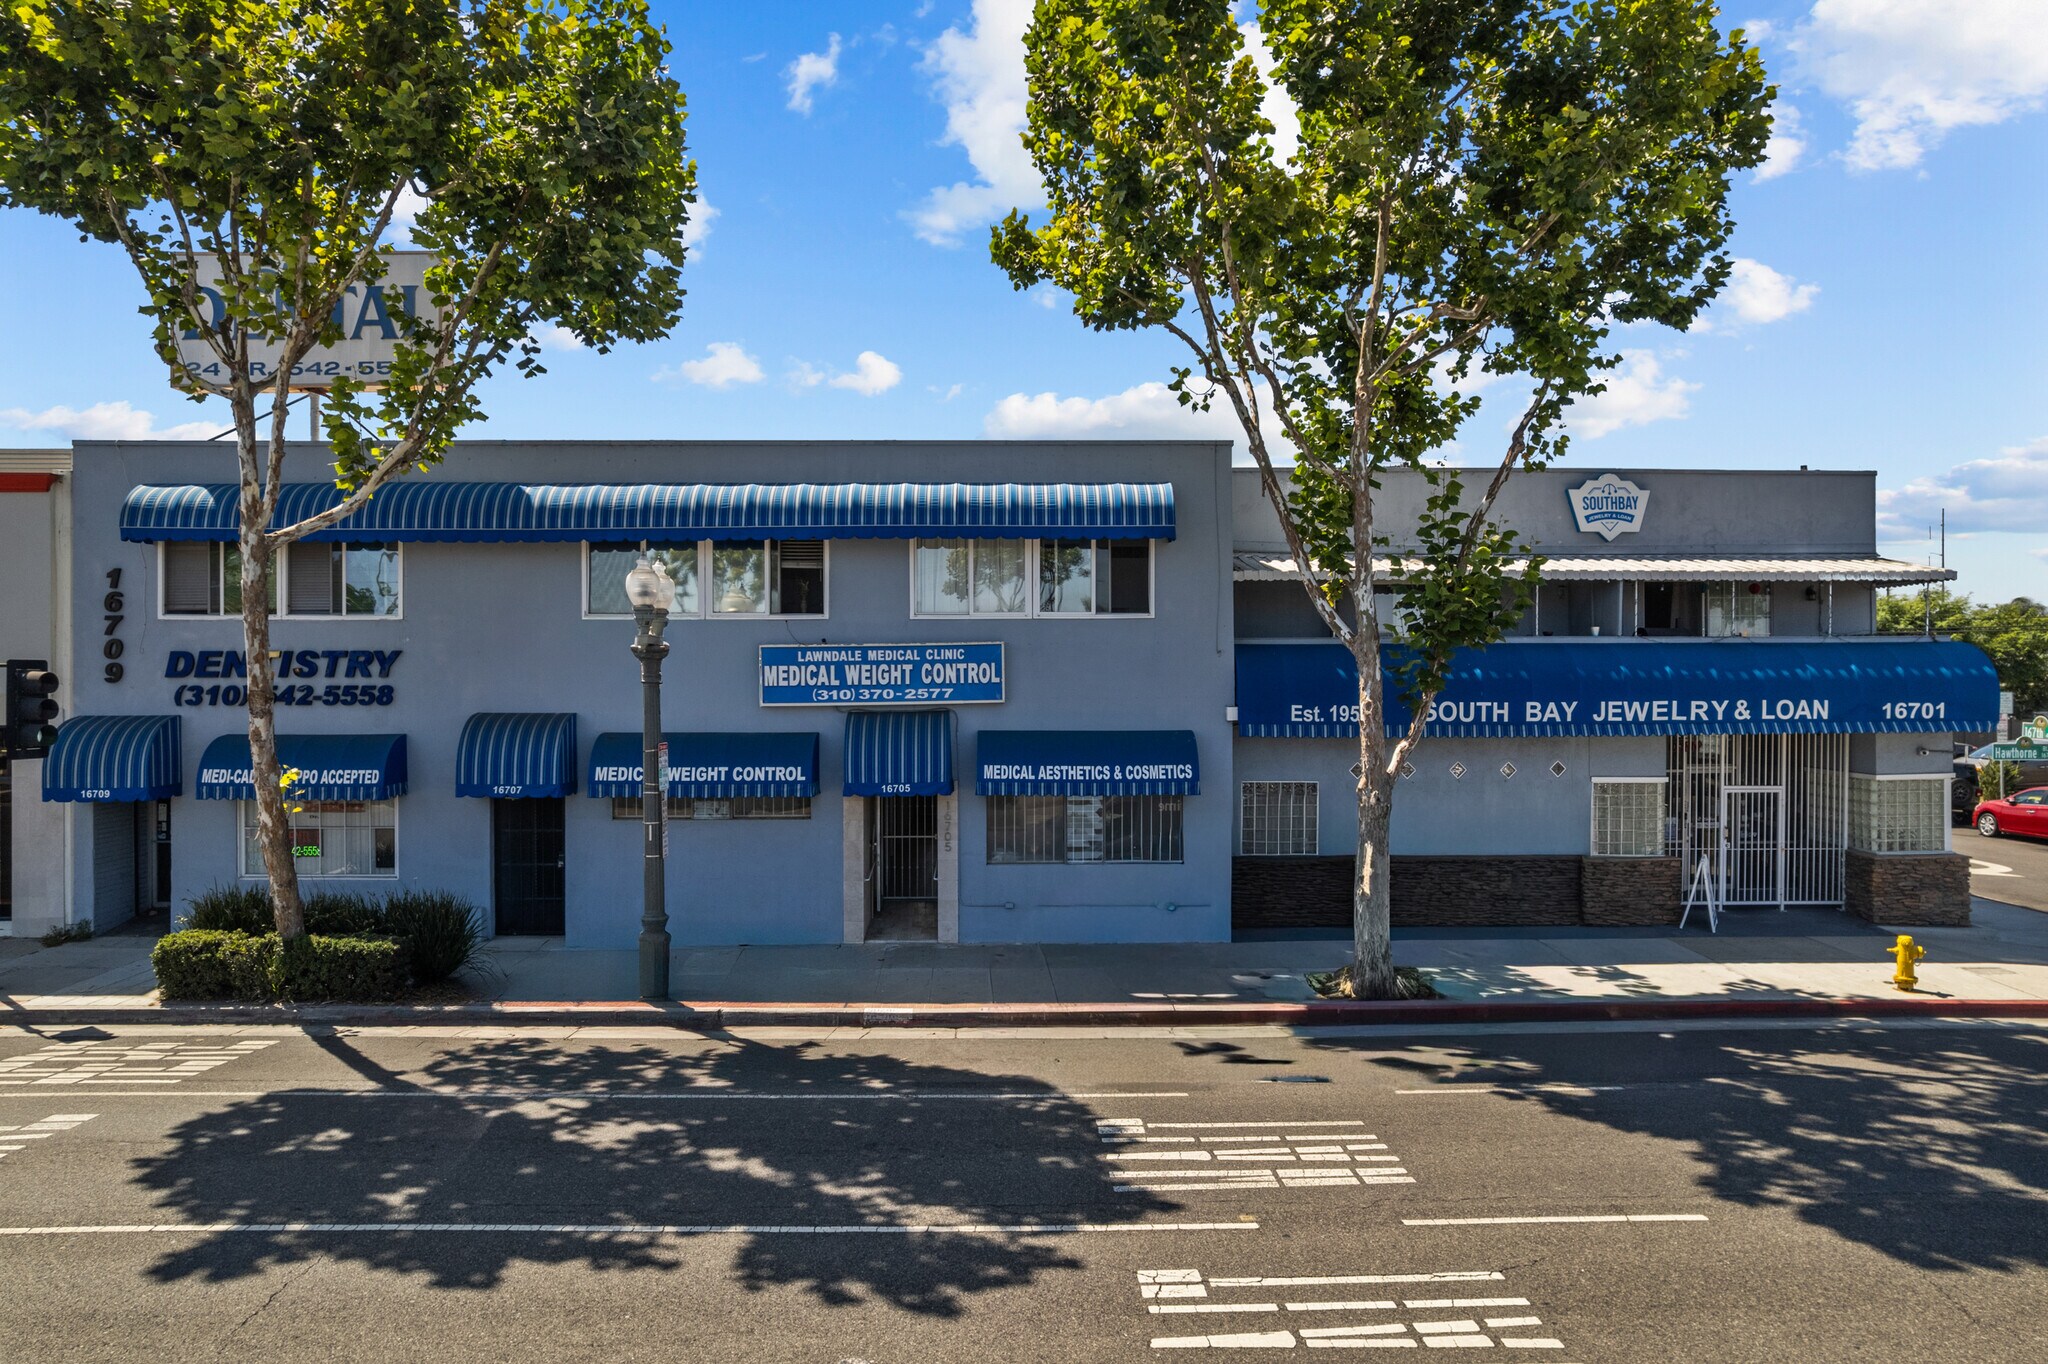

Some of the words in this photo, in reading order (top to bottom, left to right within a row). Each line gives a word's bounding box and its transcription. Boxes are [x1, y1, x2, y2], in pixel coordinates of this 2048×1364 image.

[1582, 496, 1639, 510] SOUTHBAY
[1588, 513, 1611, 521] JEWELRY
[1618, 513, 1632, 521] LOAN
[103, 568, 125, 684] 16709
[797, 650, 862, 662] LAWNDALE
[868, 649, 921, 660] MEDICAL
[926, 648, 965, 660] CLINIC
[165, 650, 403, 678] DENISTRY
[764, 665, 840, 687] MEDICAL
[845, 664, 913, 685] WEIGHT
[921, 662, 1000, 684] CONTROL
[812, 688, 855, 701] (310)
[858, 688, 954, 700] 370-2577
[1291, 705, 1324, 722] Est.
[1425, 701, 1509, 723] SOUTH
[1526, 701, 1578, 723] BAY
[1593, 699, 1729, 722] JEWELRY
[1734, 700, 1751, 721] &
[1761, 699, 1829, 721] LOAN
[1882, 702, 1946, 720] 16701
[1995, 747, 2037, 759] Hawthorne
[320, 769, 380, 784] ACCEPTED
[594, 766, 643, 782] MEDIC
[668, 766, 729, 782] WEIGHT
[732, 766, 806, 782] CONTROL
[984, 764, 1035, 780] MEDICAL
[1038, 764, 1110, 780] AESTHETICS
[1113, 765, 1123, 780] &
[1125, 764, 1193, 780] COSMETICS
[80, 789, 111, 799] 16709
[492, 785, 523, 795] 16707
[881, 783, 911, 793] 16705
